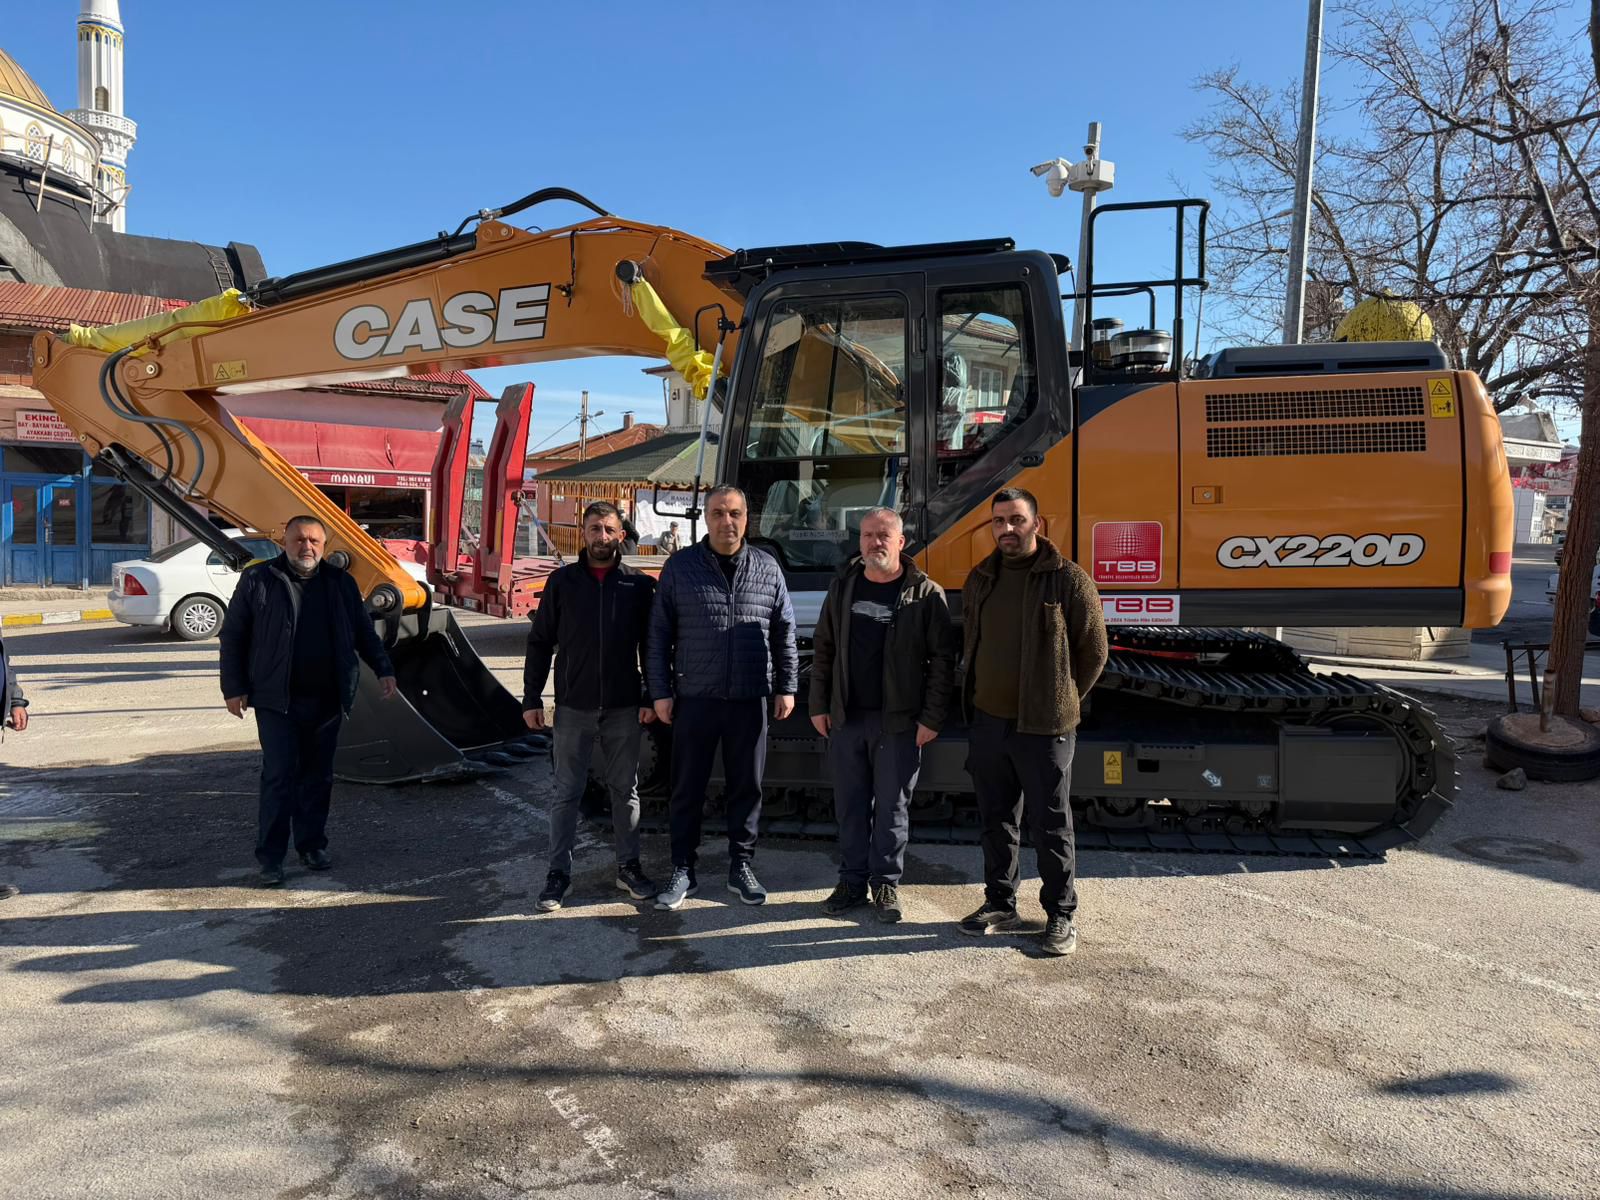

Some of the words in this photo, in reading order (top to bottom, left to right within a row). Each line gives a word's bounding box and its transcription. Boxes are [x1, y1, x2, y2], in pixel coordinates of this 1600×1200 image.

[333, 282, 552, 361] CASE
[330, 473, 376, 484] MANAVI
[1216, 533, 1426, 569] CX220D
[1098, 560, 1157, 572] TBB
